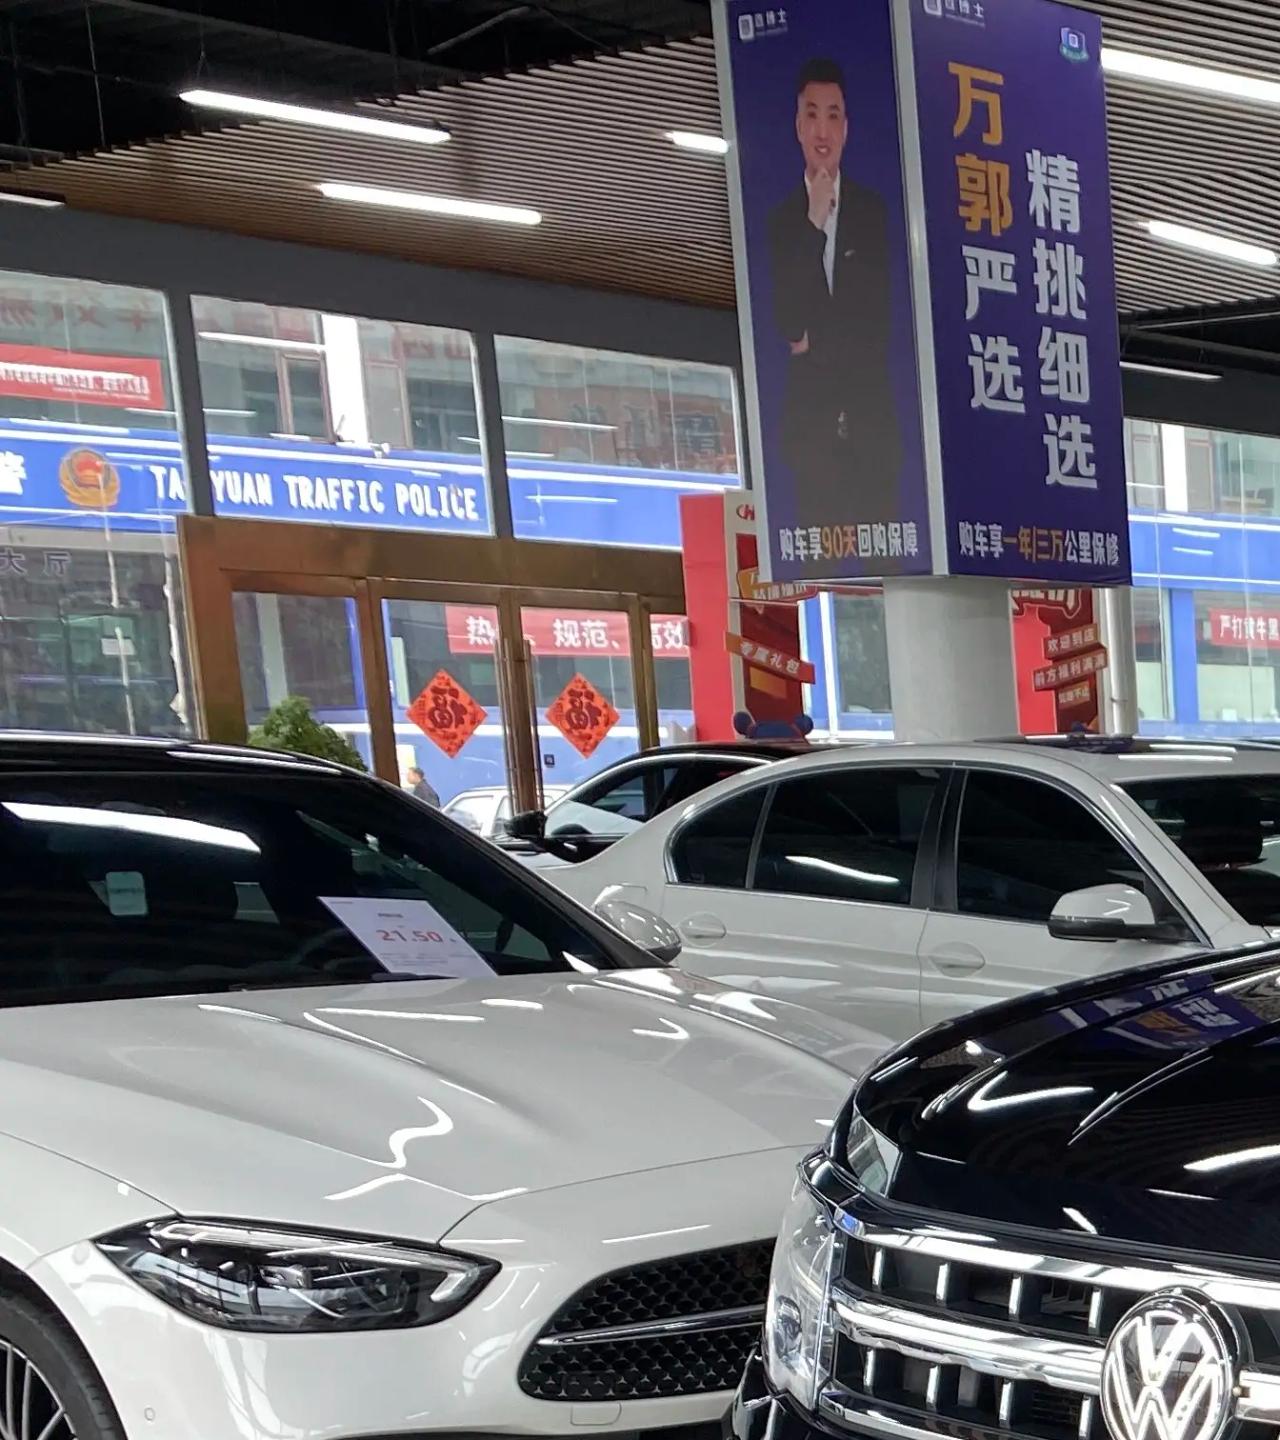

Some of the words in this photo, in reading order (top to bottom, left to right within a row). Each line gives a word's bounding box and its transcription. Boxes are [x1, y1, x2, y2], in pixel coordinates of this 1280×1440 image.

[948, 61, 1026, 414] 万郭严选
[1025, 148, 1099, 489] 精挑细选
[147, 465, 273, 506] TAYUAN
[283, 474, 385, 514] TRAFFIC
[395, 482, 480, 520] POLICE
[779, 521, 919, 561] 购车享90天回购保障
[376, 929, 444, 943] 21.50
